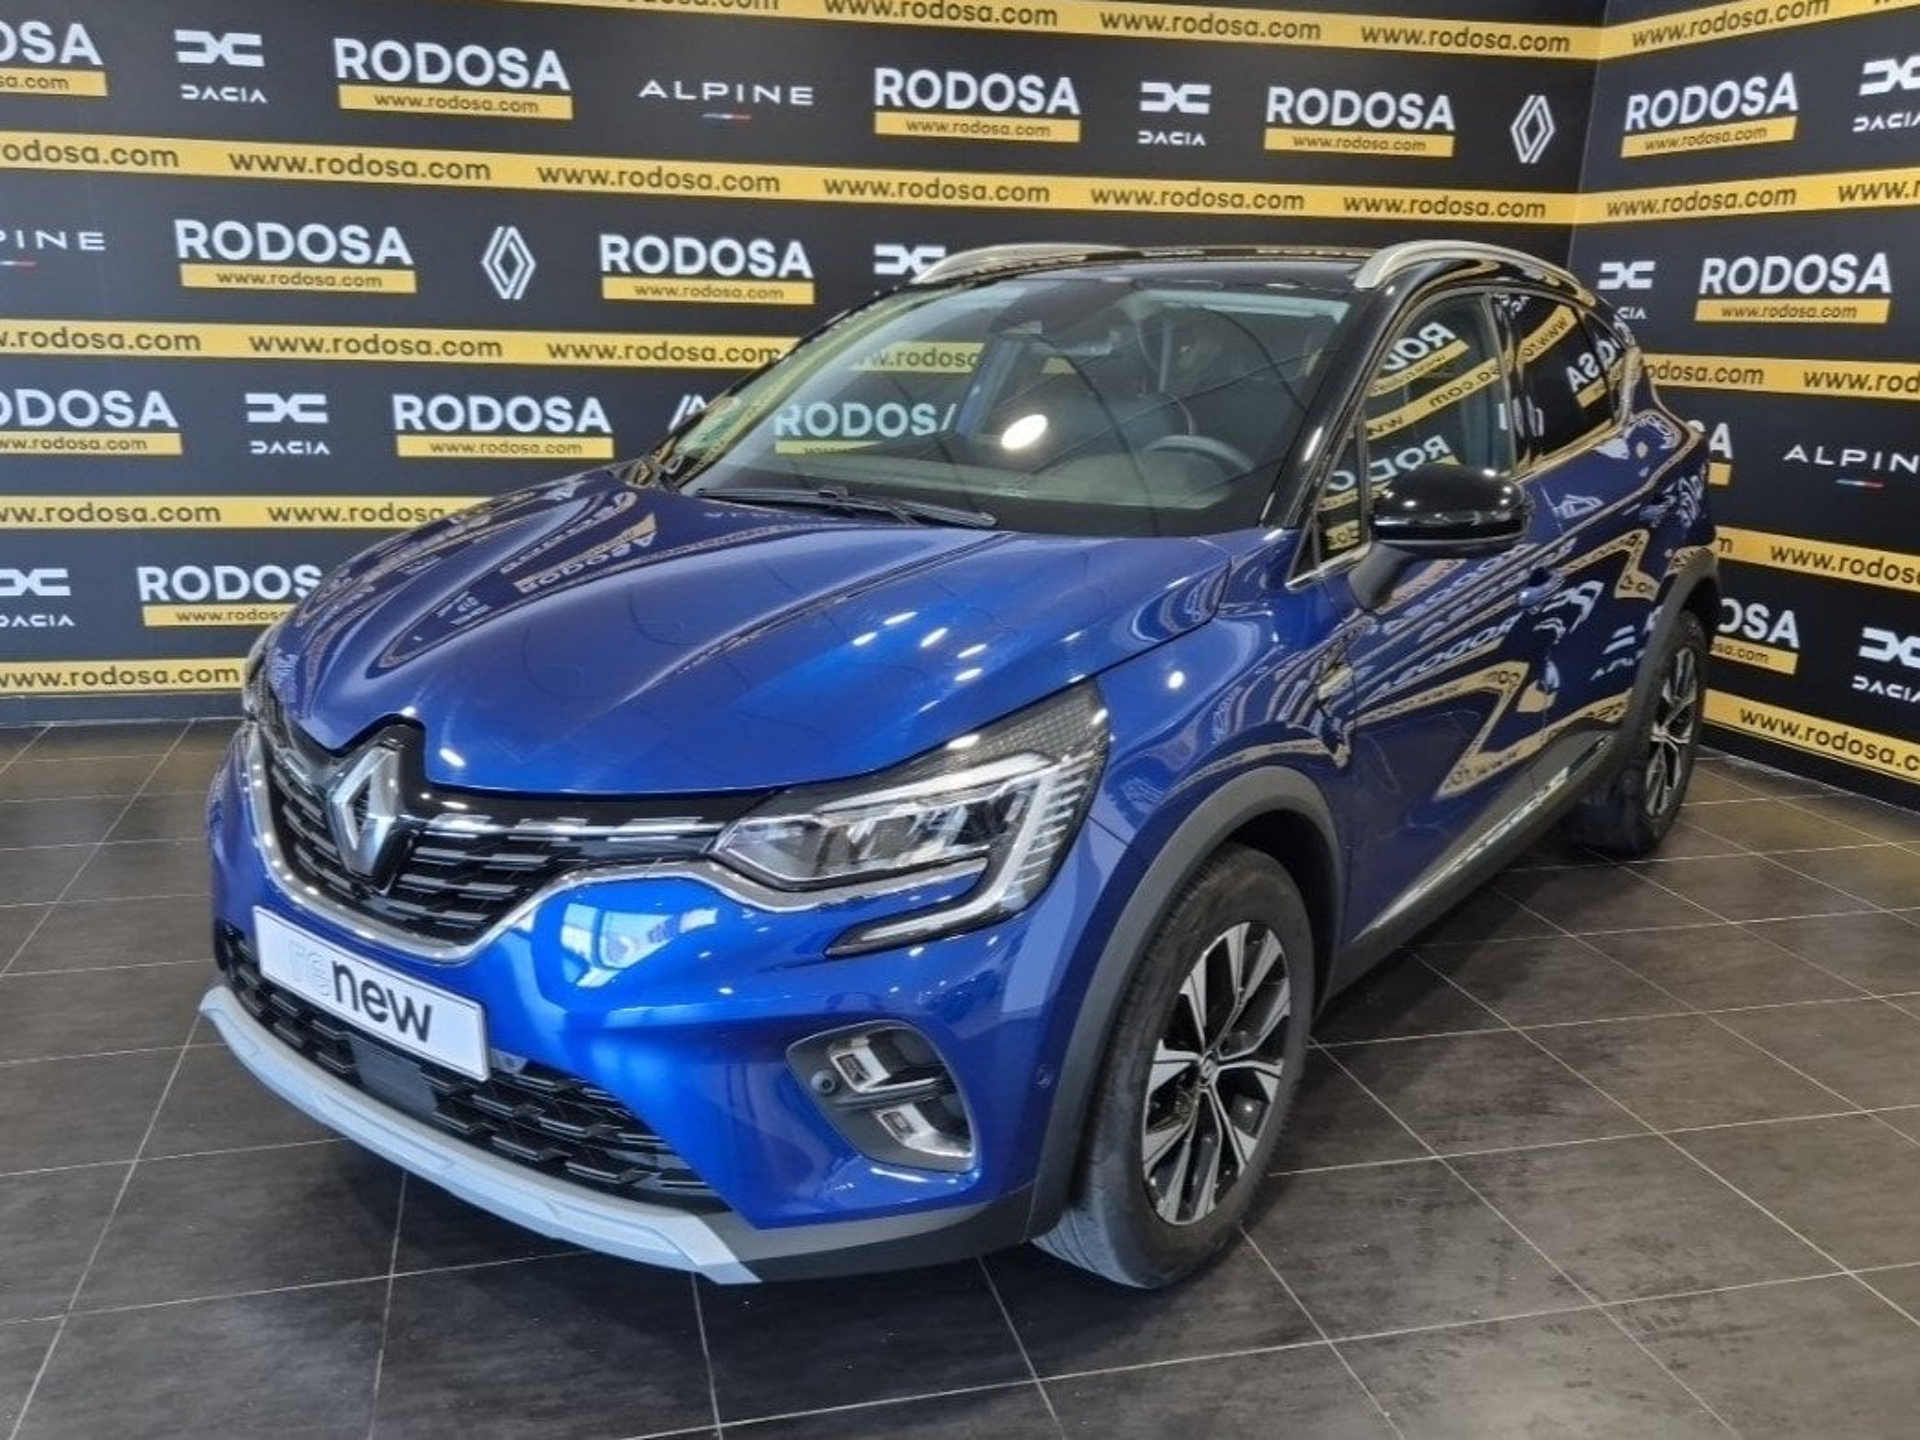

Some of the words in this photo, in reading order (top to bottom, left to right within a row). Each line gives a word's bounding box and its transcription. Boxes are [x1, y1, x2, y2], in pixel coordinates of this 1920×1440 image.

[825, 0, 1058, 26] www.rodosa.com
[1101, 12, 1321, 41] www.rodosa.com
[1361, 25, 1570, 53] www.rodosa.com
[1632, 0, 1829, 48] www.rodosa.com
[332, 37, 572, 91] RODOSA
[180, 84, 268, 104] DACIA
[374, 92, 540, 114] www.rodosa.com
[638, 79, 815, 105] ALPINE
[874, 67, 1082, 115] RODOSA
[1623, 72, 1799, 132] RODOSA
[1265, 86, 1456, 131] RODOSA
[905, 118, 1052, 139] www.rodosa.com
[1137, 131, 1207, 147] DACIA
[1644, 126, 1768, 151] www.rodosa.com
[1292, 133, 1427, 153] www.rodosa.com
[0, 139, 179, 168] odosa.com
[228, 151, 492, 182] www.rodosa.com
[538, 164, 780, 194] www.rodosa.com
[823, 174, 1051, 203] www.rodosa.com
[1090, 187, 1305, 211] www.rodosa.com
[1343, 194, 1546, 219] www.rodosa.com
[1607, 187, 1797, 217] www.rodosa.com
[0, 230, 105, 251] INE
[174, 219, 413, 266] RODOSA
[600, 234, 814, 280] RODOSA
[216, 270, 383, 290] www.rodosa.com
[1698, 252, 1893, 296] RODOSA
[634, 281, 784, 301] www.rodosa.com
[1721, 302, 1857, 321] www.rodosa.com
[249, 332, 503, 358] www.rodosa.com
[546, 341, 780, 365] www.rodosa.com
[1645, 361, 1764, 384] odosa.com
[392, 393, 613, 433] RODOSA
[251, 440, 331, 455] DACIA
[430, 440, 583, 456] www.rodosa.com
